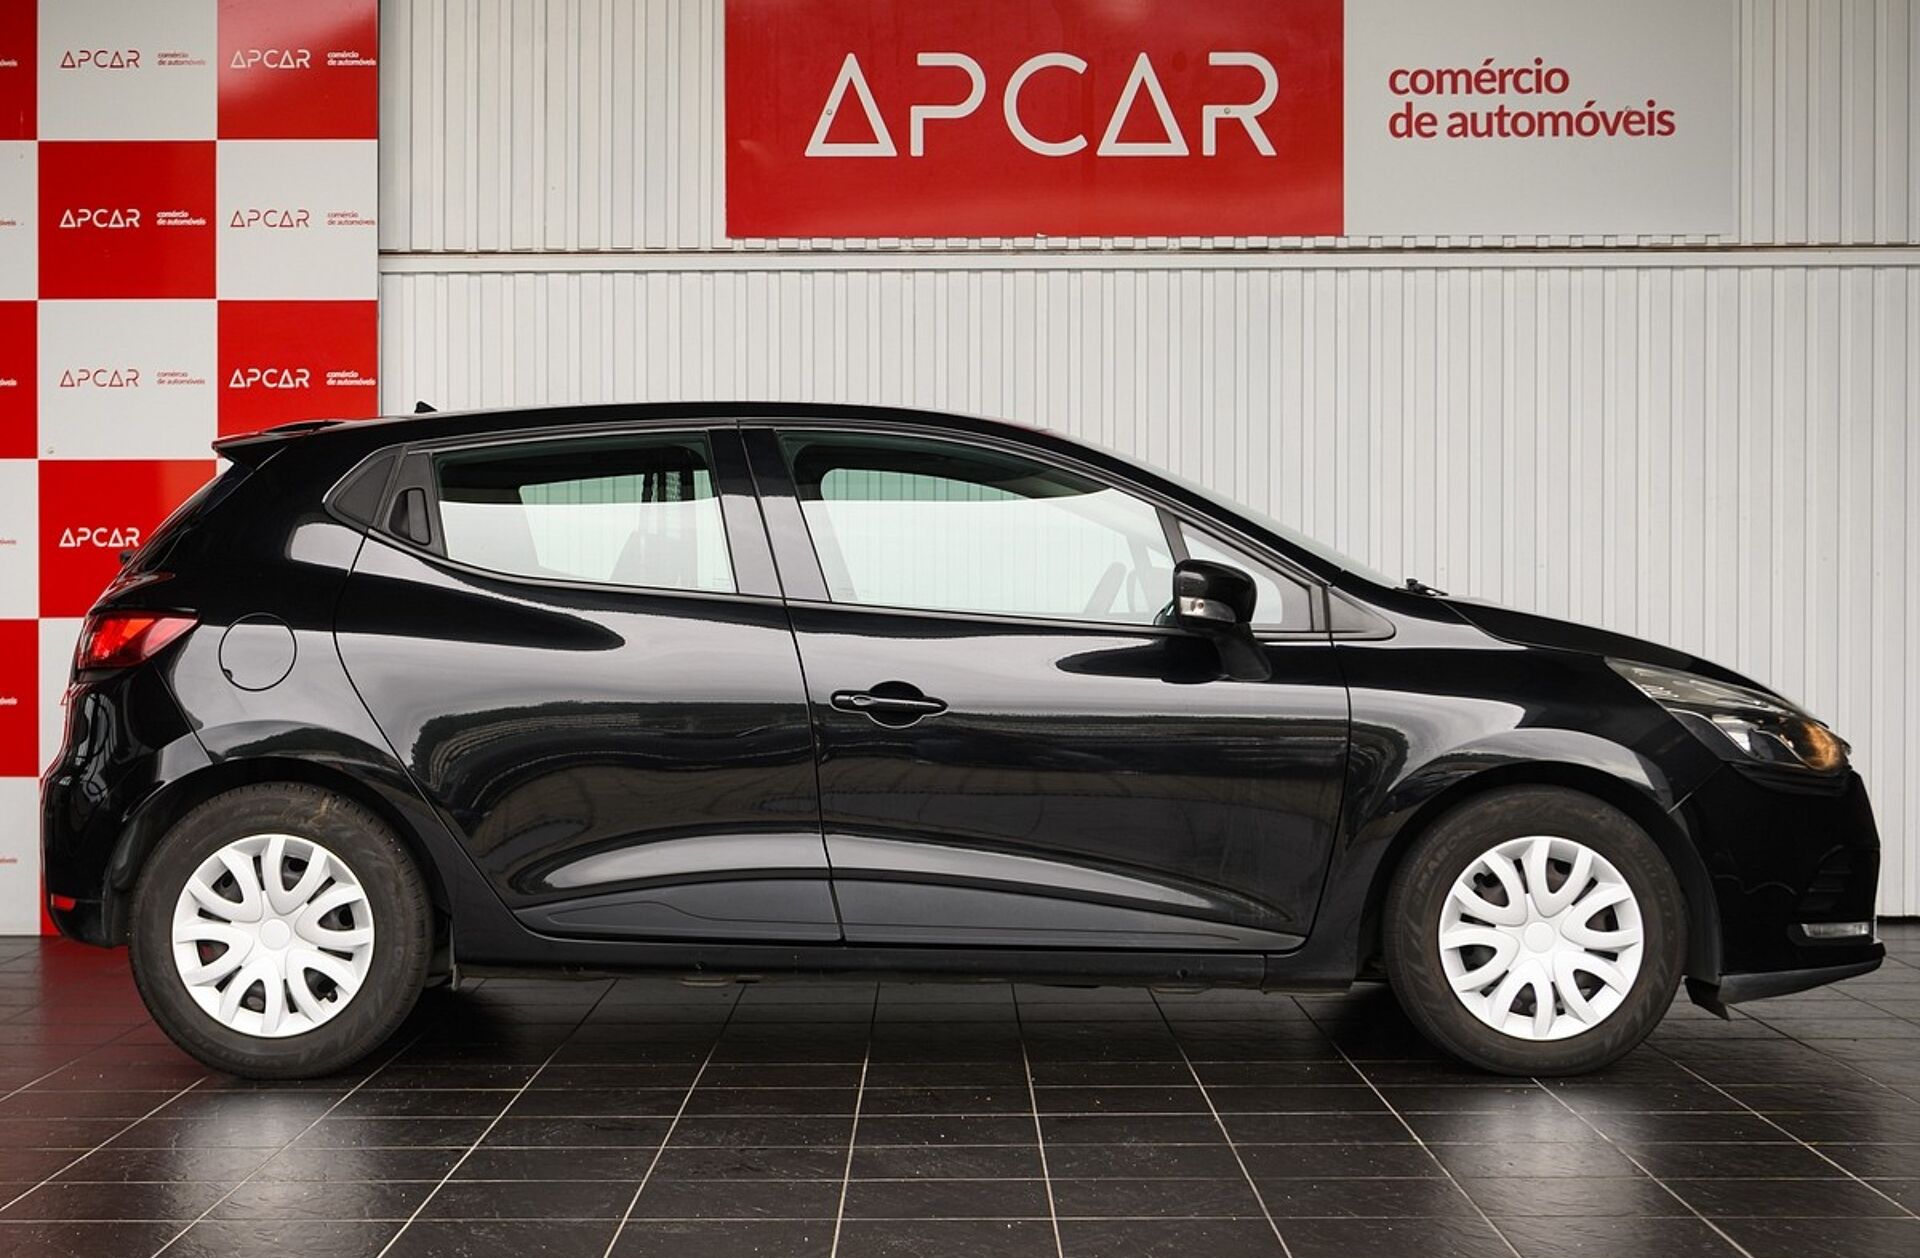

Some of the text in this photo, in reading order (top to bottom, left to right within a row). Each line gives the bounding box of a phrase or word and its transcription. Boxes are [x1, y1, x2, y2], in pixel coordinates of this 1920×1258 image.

[60, 49, 141, 68] APCAR
[230, 49, 311, 68] APCAR
[1388, 57, 1570, 95] comércio
[804, 52, 1279, 157] APCAR
[1388, 99, 1676, 138] de automóveis
[59, 209, 141, 228] APCAR
[230, 209, 310, 228] APCAR
[59, 369, 140, 388] APCAR
[229, 368, 310, 388] APCAR
[58, 527, 141, 548] APCAR
